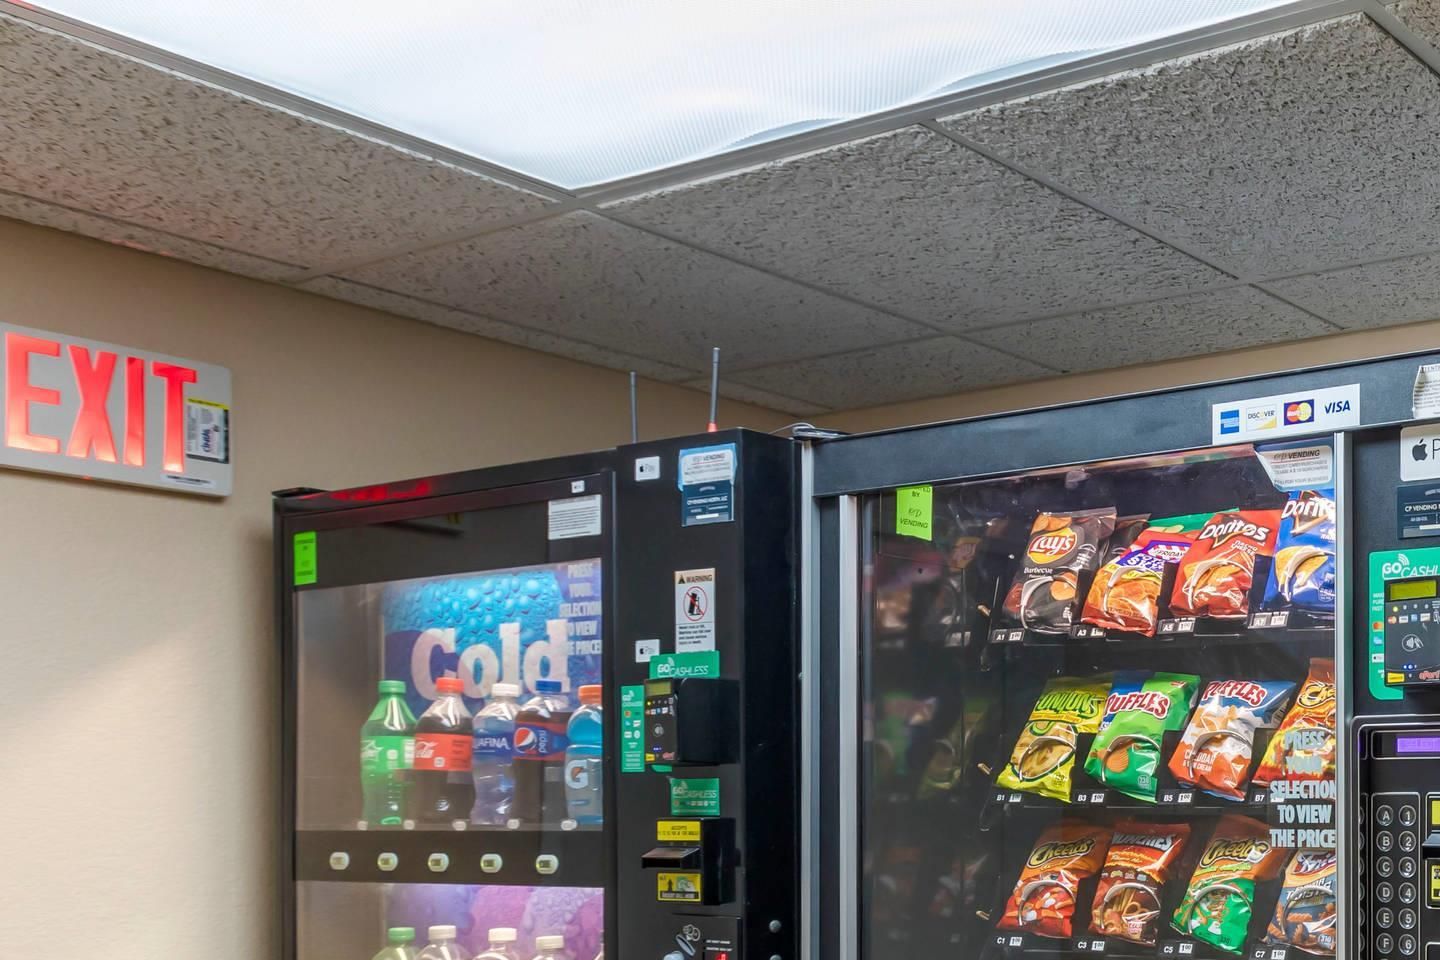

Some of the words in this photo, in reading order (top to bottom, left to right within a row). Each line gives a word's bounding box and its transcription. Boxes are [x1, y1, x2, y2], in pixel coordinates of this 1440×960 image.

[5, 331, 197, 473] EXIT
[1324, 400, 1351, 414] VISA
[1288, 449, 1320, 460] VENDING
[1413, 503, 1438, 512] VENDING
[900, 518, 929, 529] VENDING
[1198, 519, 1270, 542] Doritos
[1023, 566, 1054, 575] Barbecue
[1382, 561, 1403, 577] GO
[686, 574, 713, 584] WARNING
[1077, 629, 1087, 637] A3
[1162, 624, 1175, 632] A5
[996, 632, 1005, 641] A1
[411, 618, 570, 702] Cold
[657, 663, 671, 674] GO
[670, 665, 709, 676] CASHLESS
[1202, 679, 1267, 707] RUFFLES
[1105, 690, 1170, 719] RUFFLES
[1284, 730, 1326, 750] PRESS
[564, 759, 589, 789] G
[1270, 780, 1336, 799] SELECTION
[1255, 794, 1265, 802] B7
[1277, 804, 1296, 824] TO
[1296, 804, 1332, 824] VIEW
[1382, 810, 1391, 821] A
[1405, 810, 1411, 821] 1
[1269, 828, 1296, 848] THE
[1297, 828, 1336, 848] PRICE
[1382, 836, 1391, 847] B
[1405, 837, 1412, 847] 2
[1028, 839, 1094, 867] Cheetos
[1382, 862, 1391, 872] C
[1405, 862, 1412, 873] 3
[1382, 887, 1391, 898] D
[1405, 888, 1412, 898] 4
[1382, 912, 1390, 923] E
[1405, 913, 1412, 924] 5
[996, 936, 1005, 945] C1
[1078, 940, 1087, 949] C3
[1382, 938, 1390, 949] F
[1405, 939, 1412, 950] 6
[1163, 945, 1173, 954] C5
[1255, 950, 1265, 958] C7
